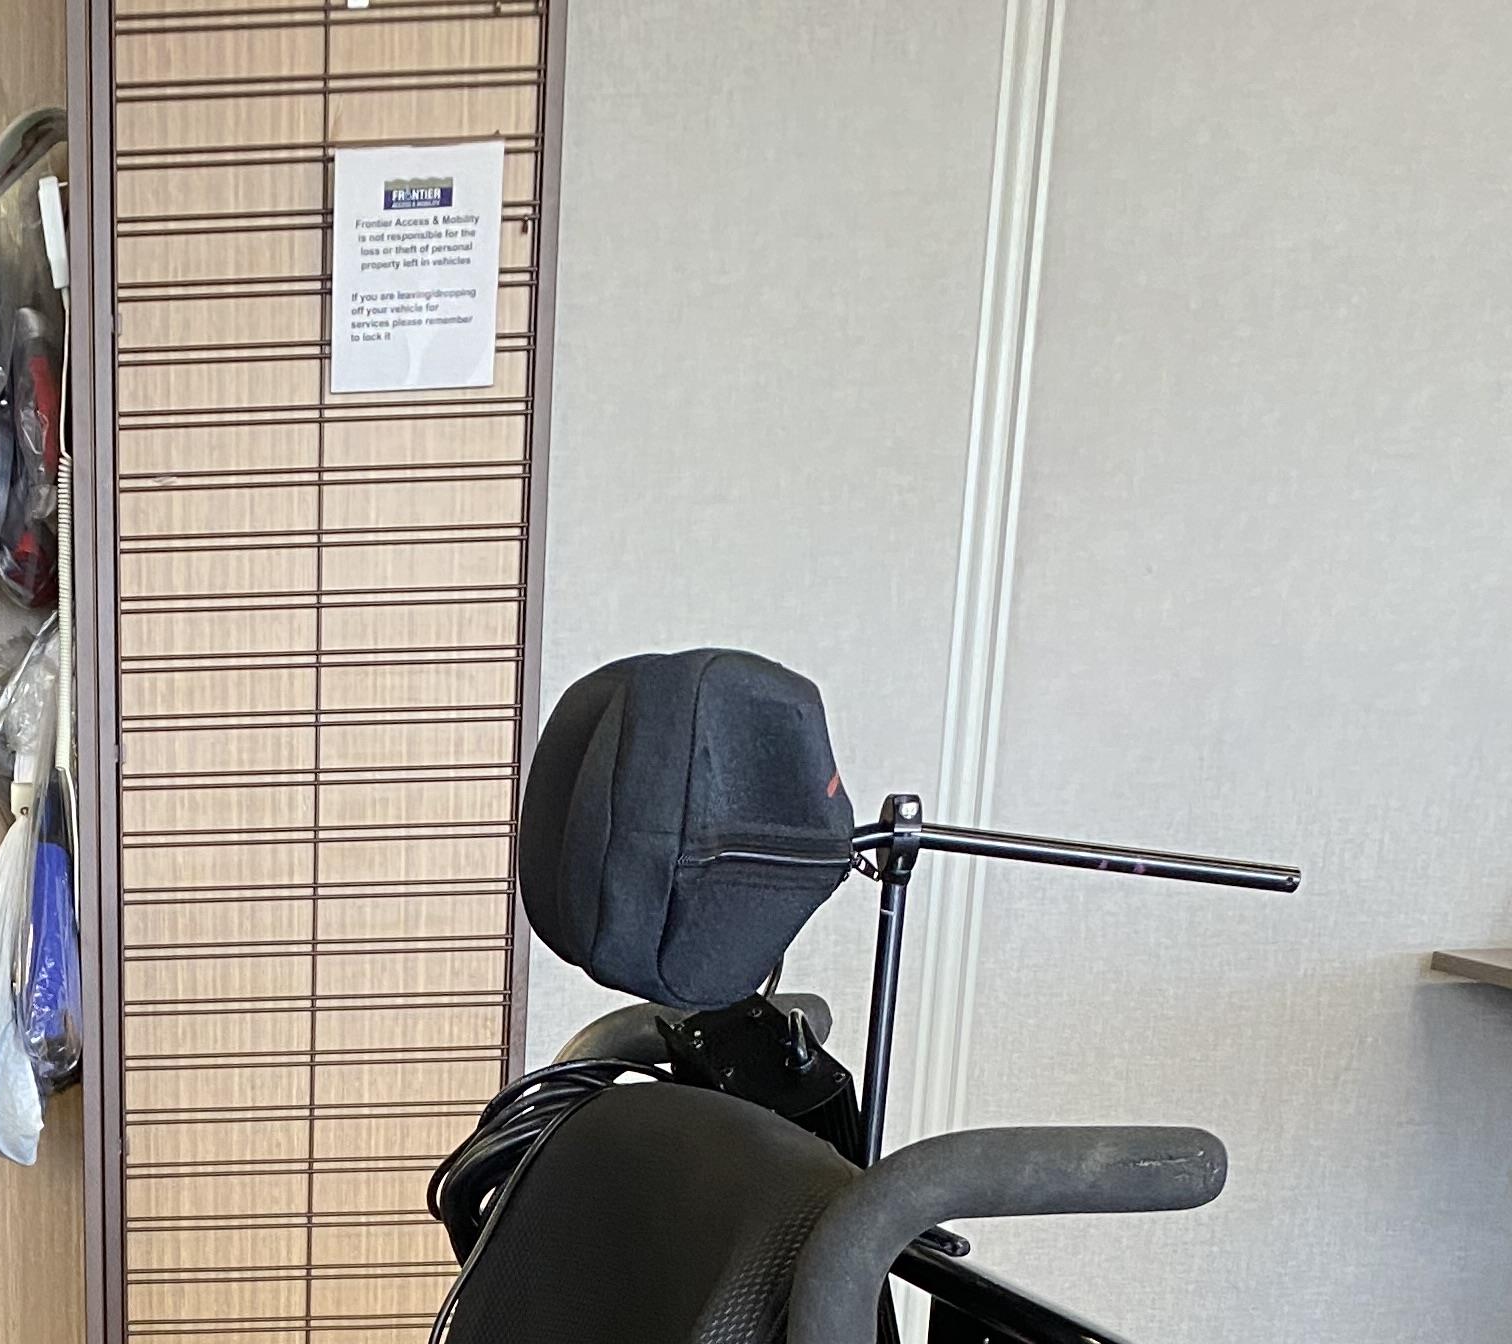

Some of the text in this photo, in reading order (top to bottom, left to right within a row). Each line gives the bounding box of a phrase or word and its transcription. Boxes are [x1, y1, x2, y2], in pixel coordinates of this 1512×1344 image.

[355, 215, 479, 229] Frontier Access & Mobility
[358, 229, 476, 242] is not responsible for the
[361, 242, 473, 256] loss or theft of personal
[361, 256, 471, 271] property left in vehicles
[351, 292, 358, 301] If
[360, 293, 378, 303] you
[380, 292, 395, 300] are
[351, 303, 439, 316] off your vehicle for
[351, 316, 473, 329] services please remember
[351, 332, 391, 342] to lock it
